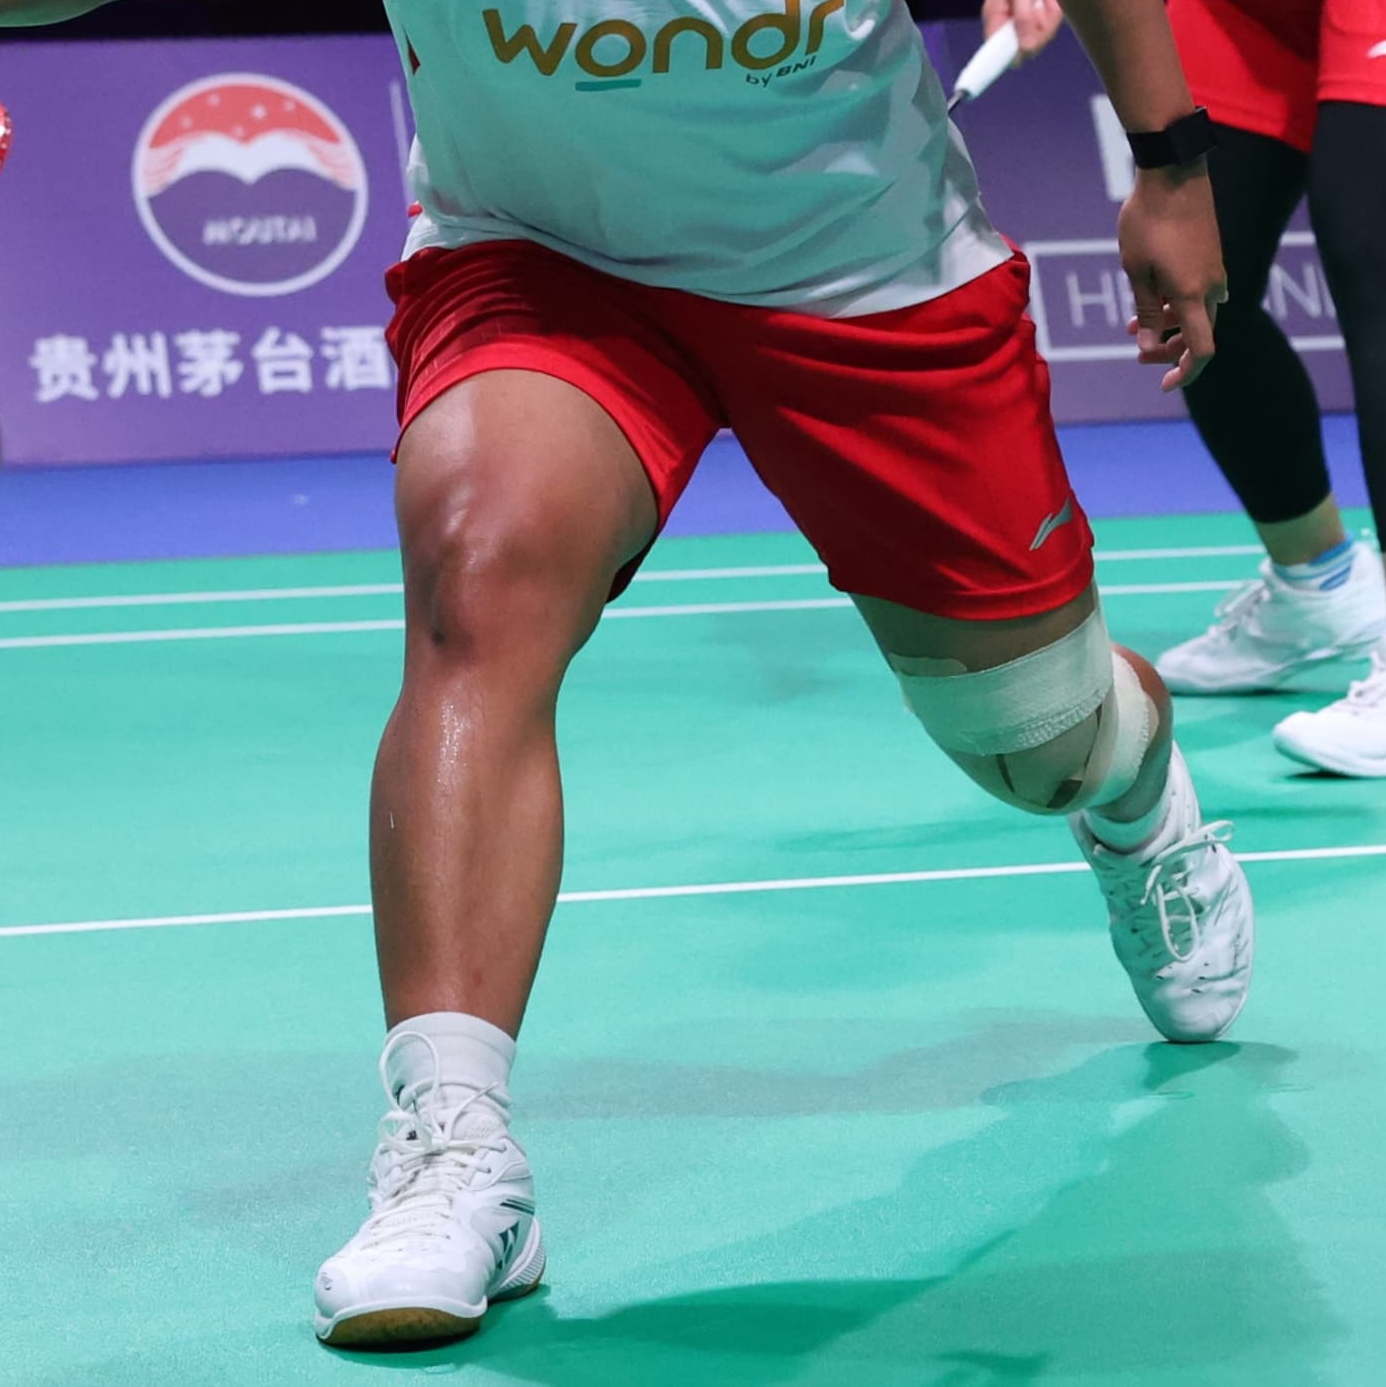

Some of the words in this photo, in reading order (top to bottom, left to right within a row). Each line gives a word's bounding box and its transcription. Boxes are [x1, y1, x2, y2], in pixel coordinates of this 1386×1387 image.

[746, 73, 772, 88] by
[776, 55, 817, 77] BNI
[28, 326, 392, 403] 贵州茅台酒
